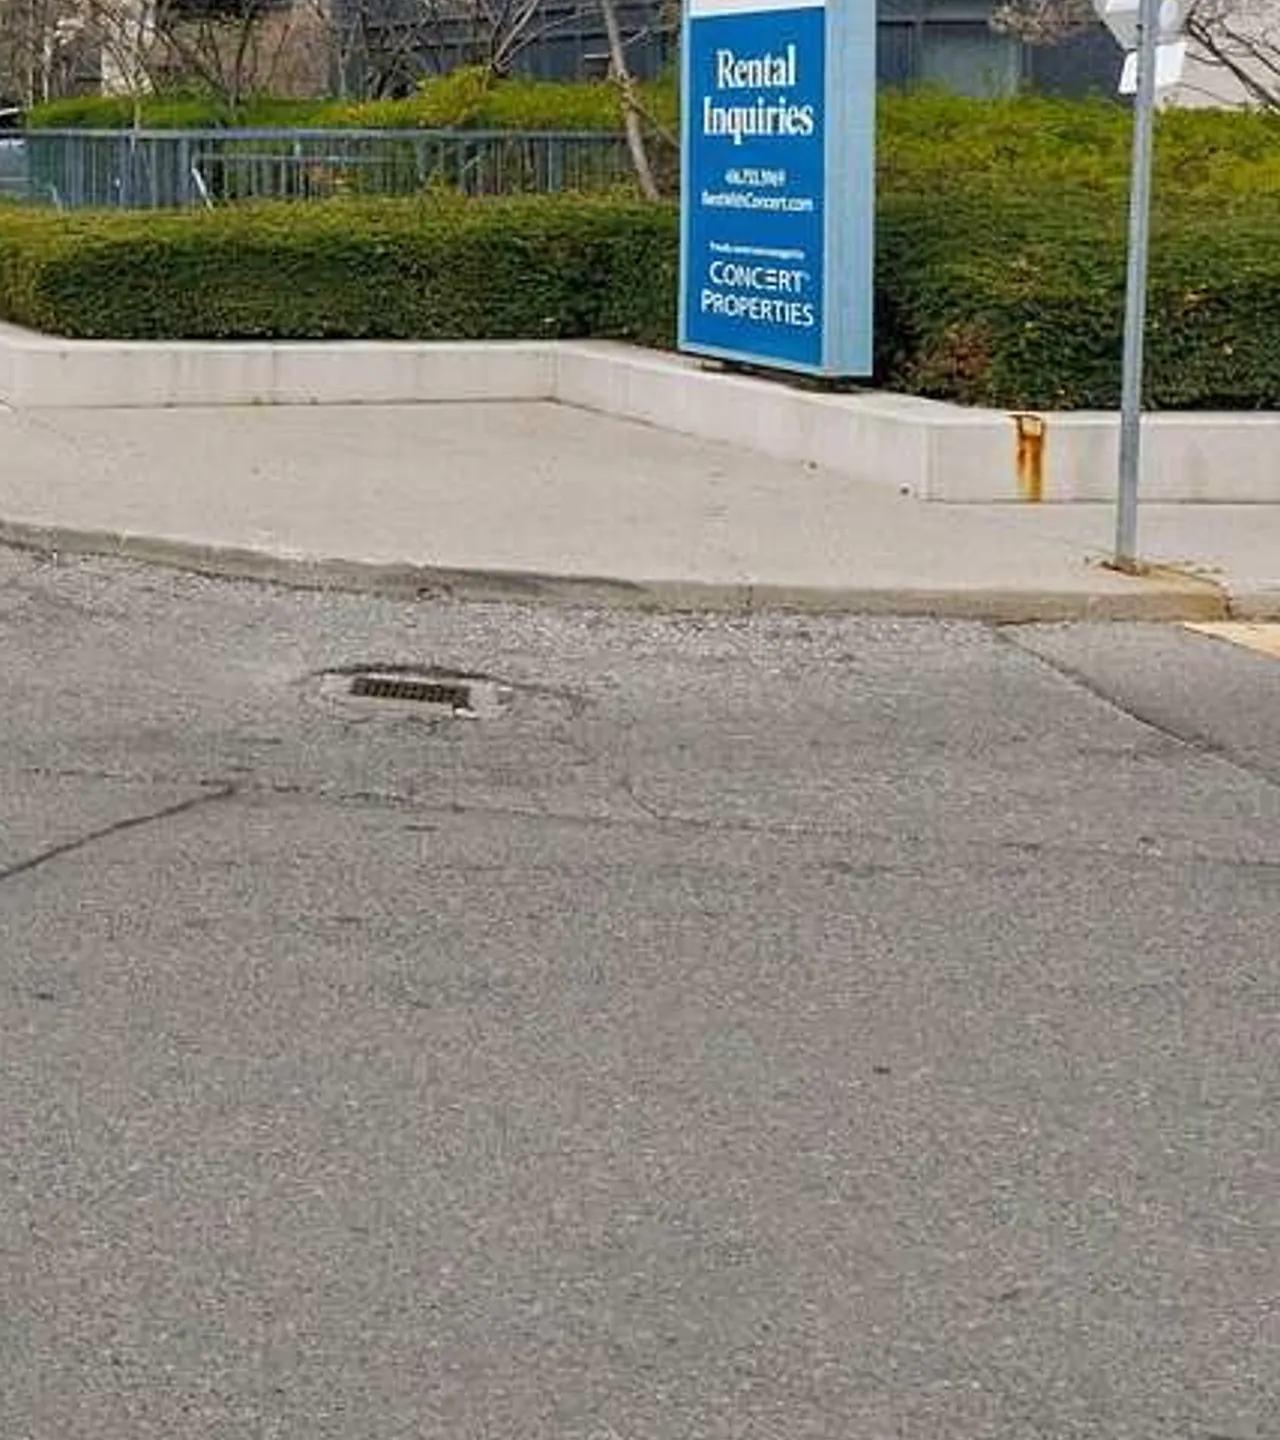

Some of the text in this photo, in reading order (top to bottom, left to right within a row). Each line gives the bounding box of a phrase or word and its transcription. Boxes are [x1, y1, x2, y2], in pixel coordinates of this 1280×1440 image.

[716, 44, 796, 89] Rental
[703, 96, 814, 145] Inquiries
[709, 261, 803, 293] CONCERT
[701, 288, 814, 326] PROPERTIES
